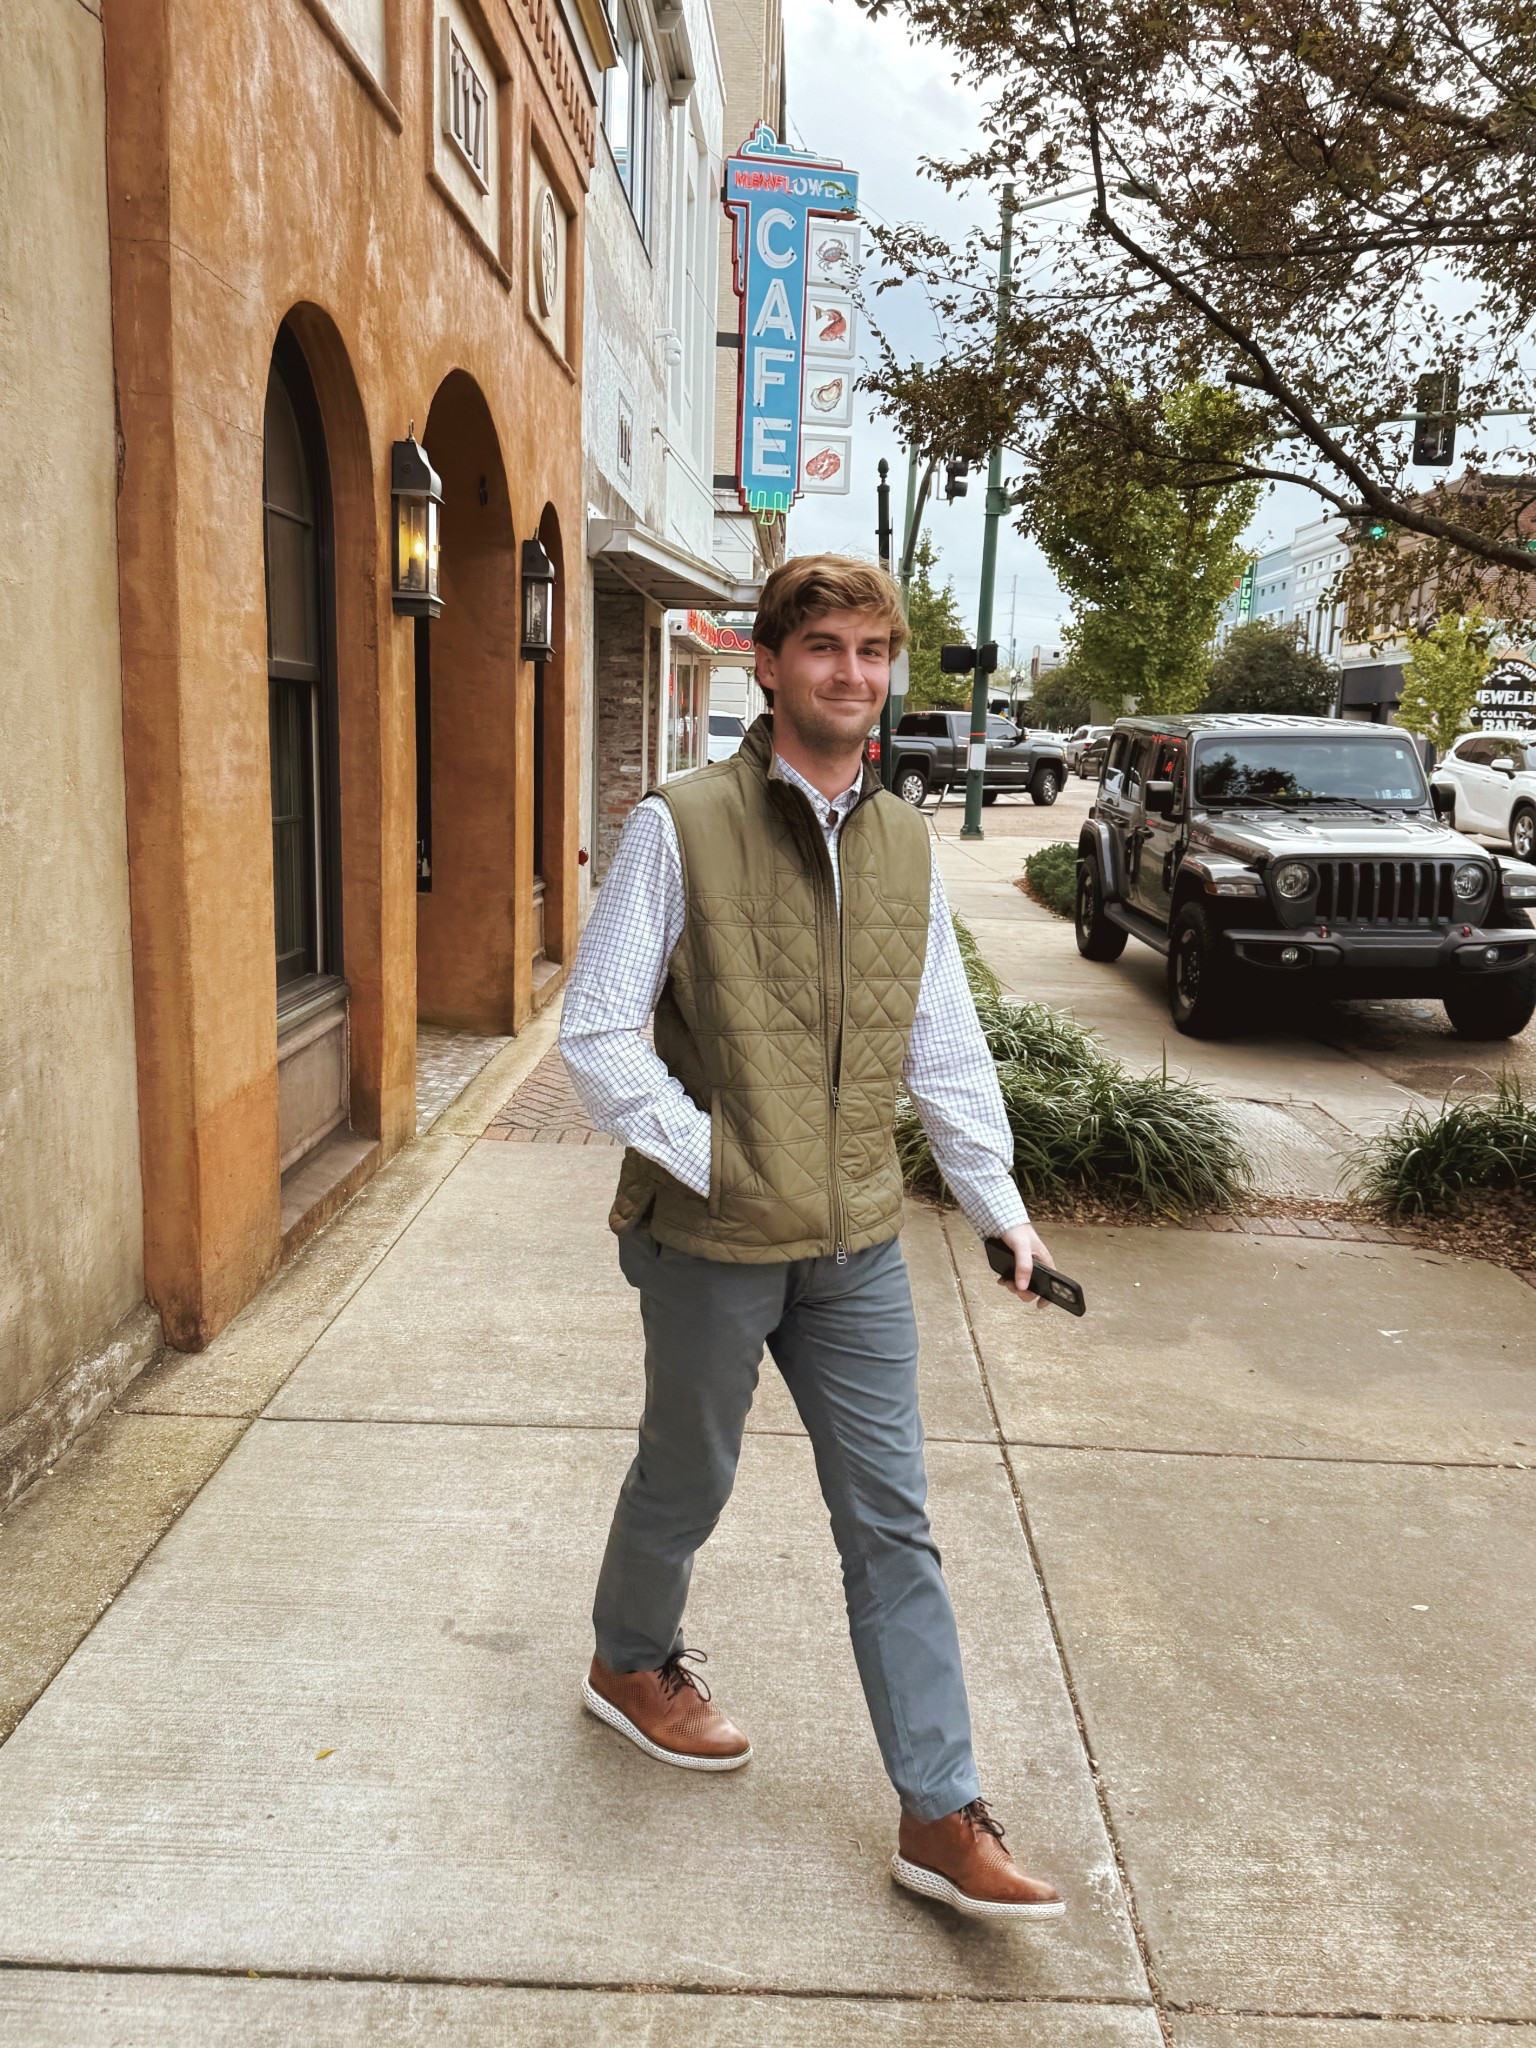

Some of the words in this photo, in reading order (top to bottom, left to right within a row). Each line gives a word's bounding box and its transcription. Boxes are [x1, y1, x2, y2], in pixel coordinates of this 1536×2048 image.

[451, 46, 486, 170] 117
[752, 208, 798, 478] CAFE
[1469, 707, 1479, 718] &
